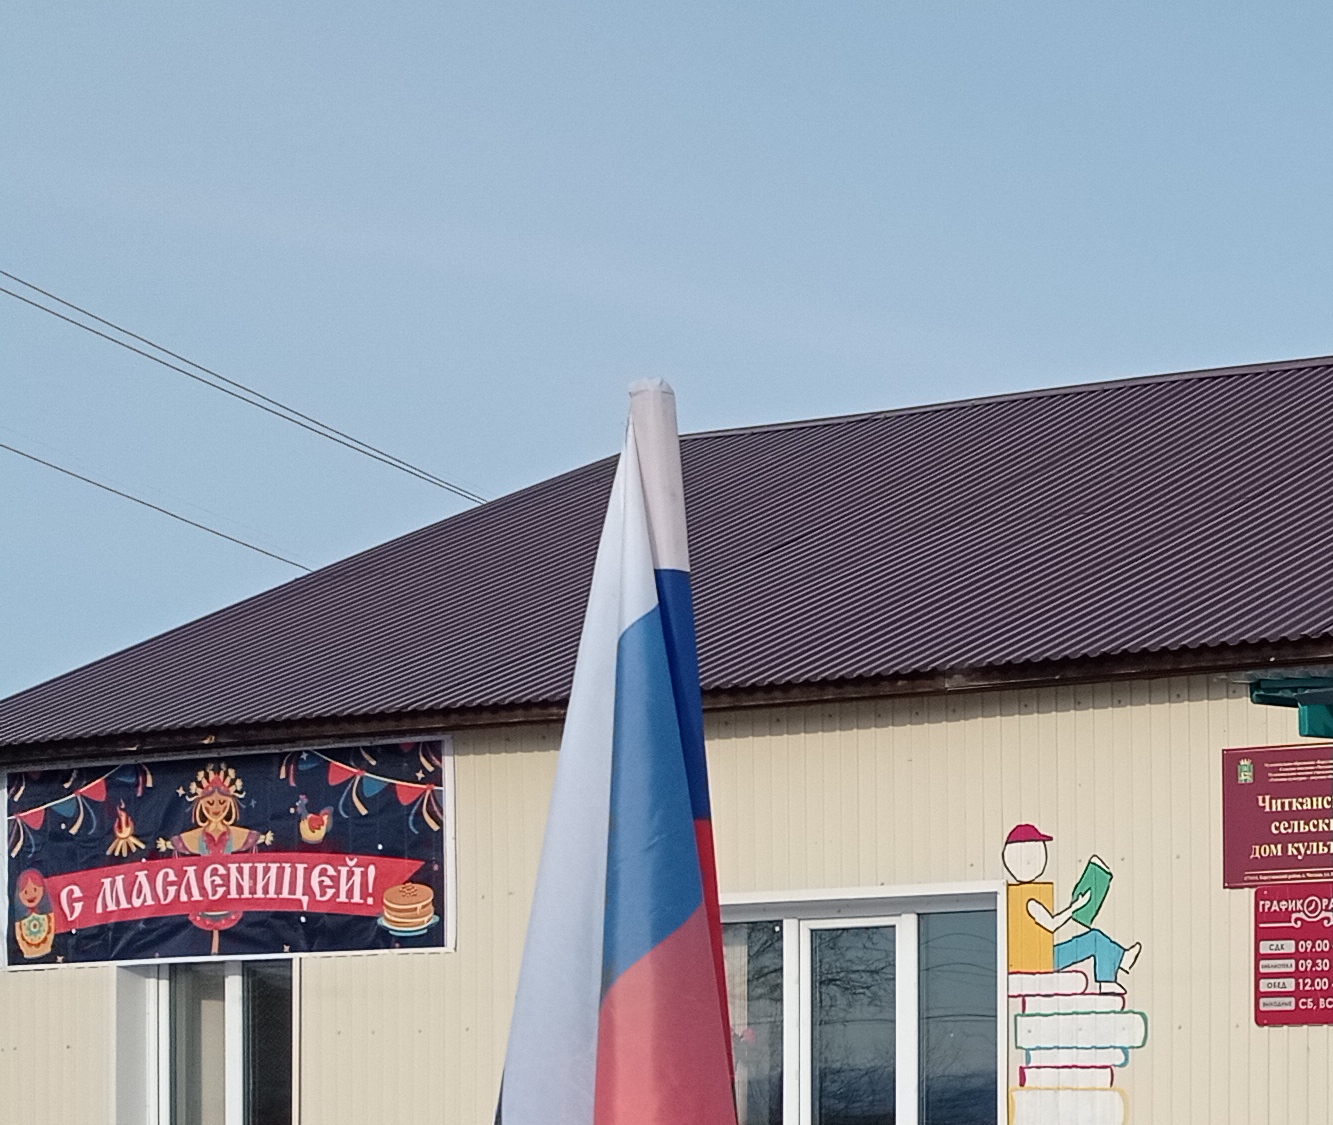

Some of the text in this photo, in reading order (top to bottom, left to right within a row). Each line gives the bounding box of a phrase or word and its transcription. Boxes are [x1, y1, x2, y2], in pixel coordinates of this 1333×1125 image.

[1250, 843, 1282, 860] дом
[60, 857, 376, 921] С МАСЛЕНИЦЕЙ!
[1259, 900, 1303, 912] ГРАФИК
[1268, 943, 1285, 952] СДК
[1298, 939, 1330, 953] 09.00
[1298, 958, 1330, 972] 09.30
[1298, 977, 1329, 991] 12.00
[1298, 997, 1317, 1010] СБ,
